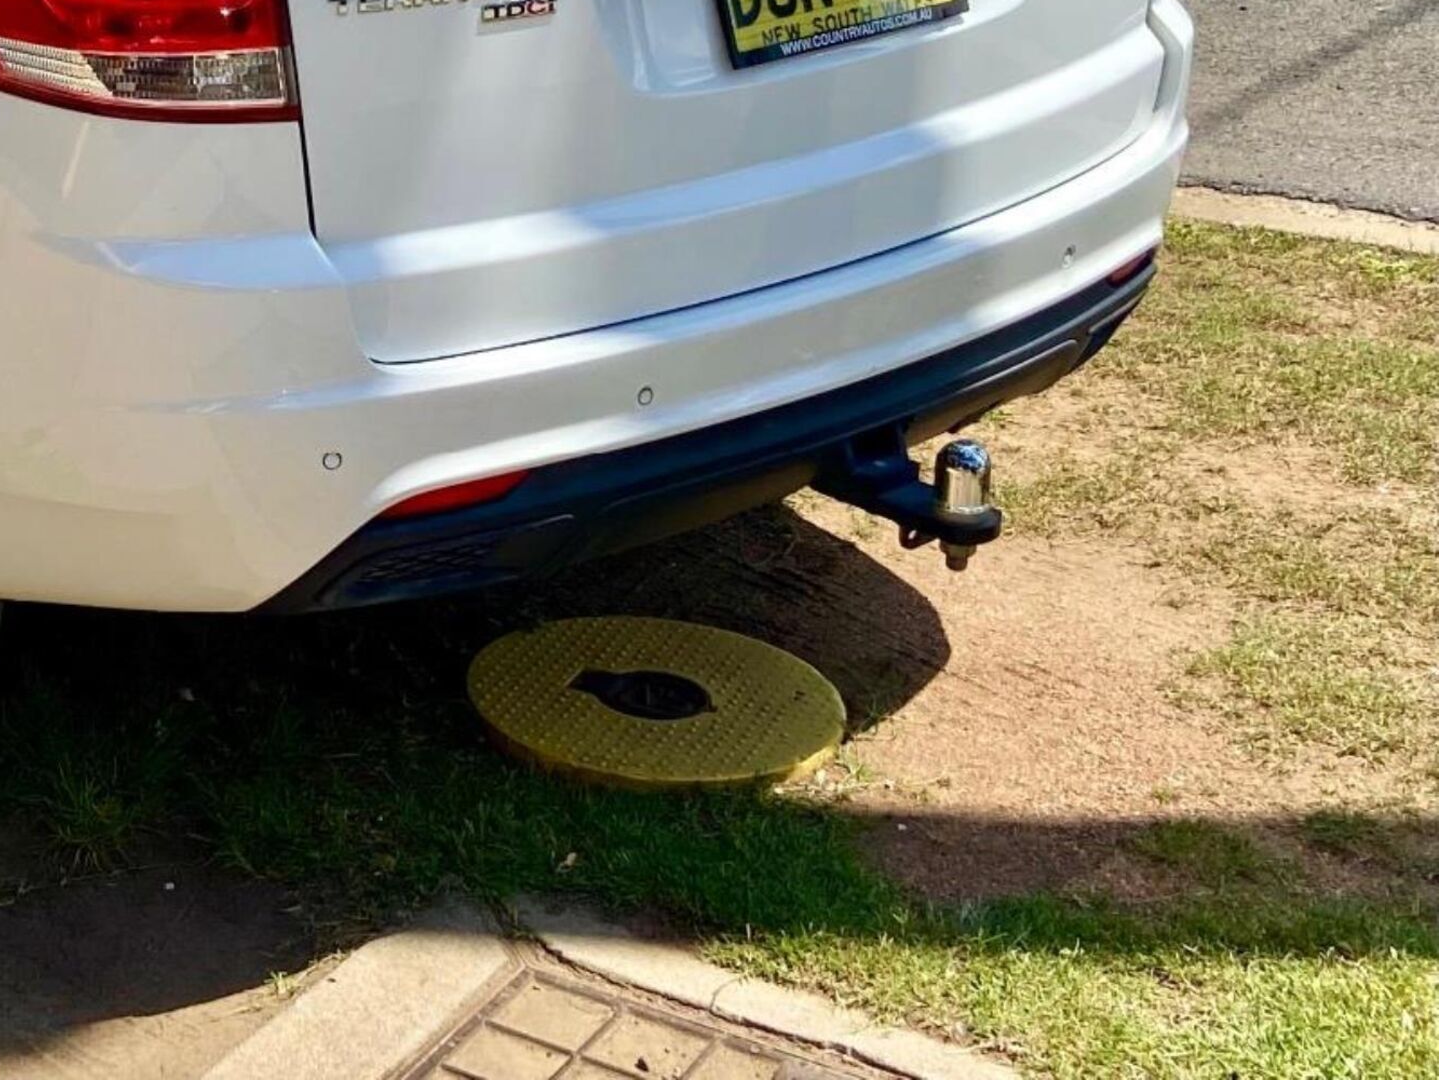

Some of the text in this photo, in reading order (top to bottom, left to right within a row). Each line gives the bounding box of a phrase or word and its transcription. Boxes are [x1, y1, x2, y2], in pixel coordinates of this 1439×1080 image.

[761, 24, 802, 46] NEW
[813, 5, 872, 35] SOUTH
[780, 7, 933, 57] WWW.COUNTRYAUTOS.COM.AU
